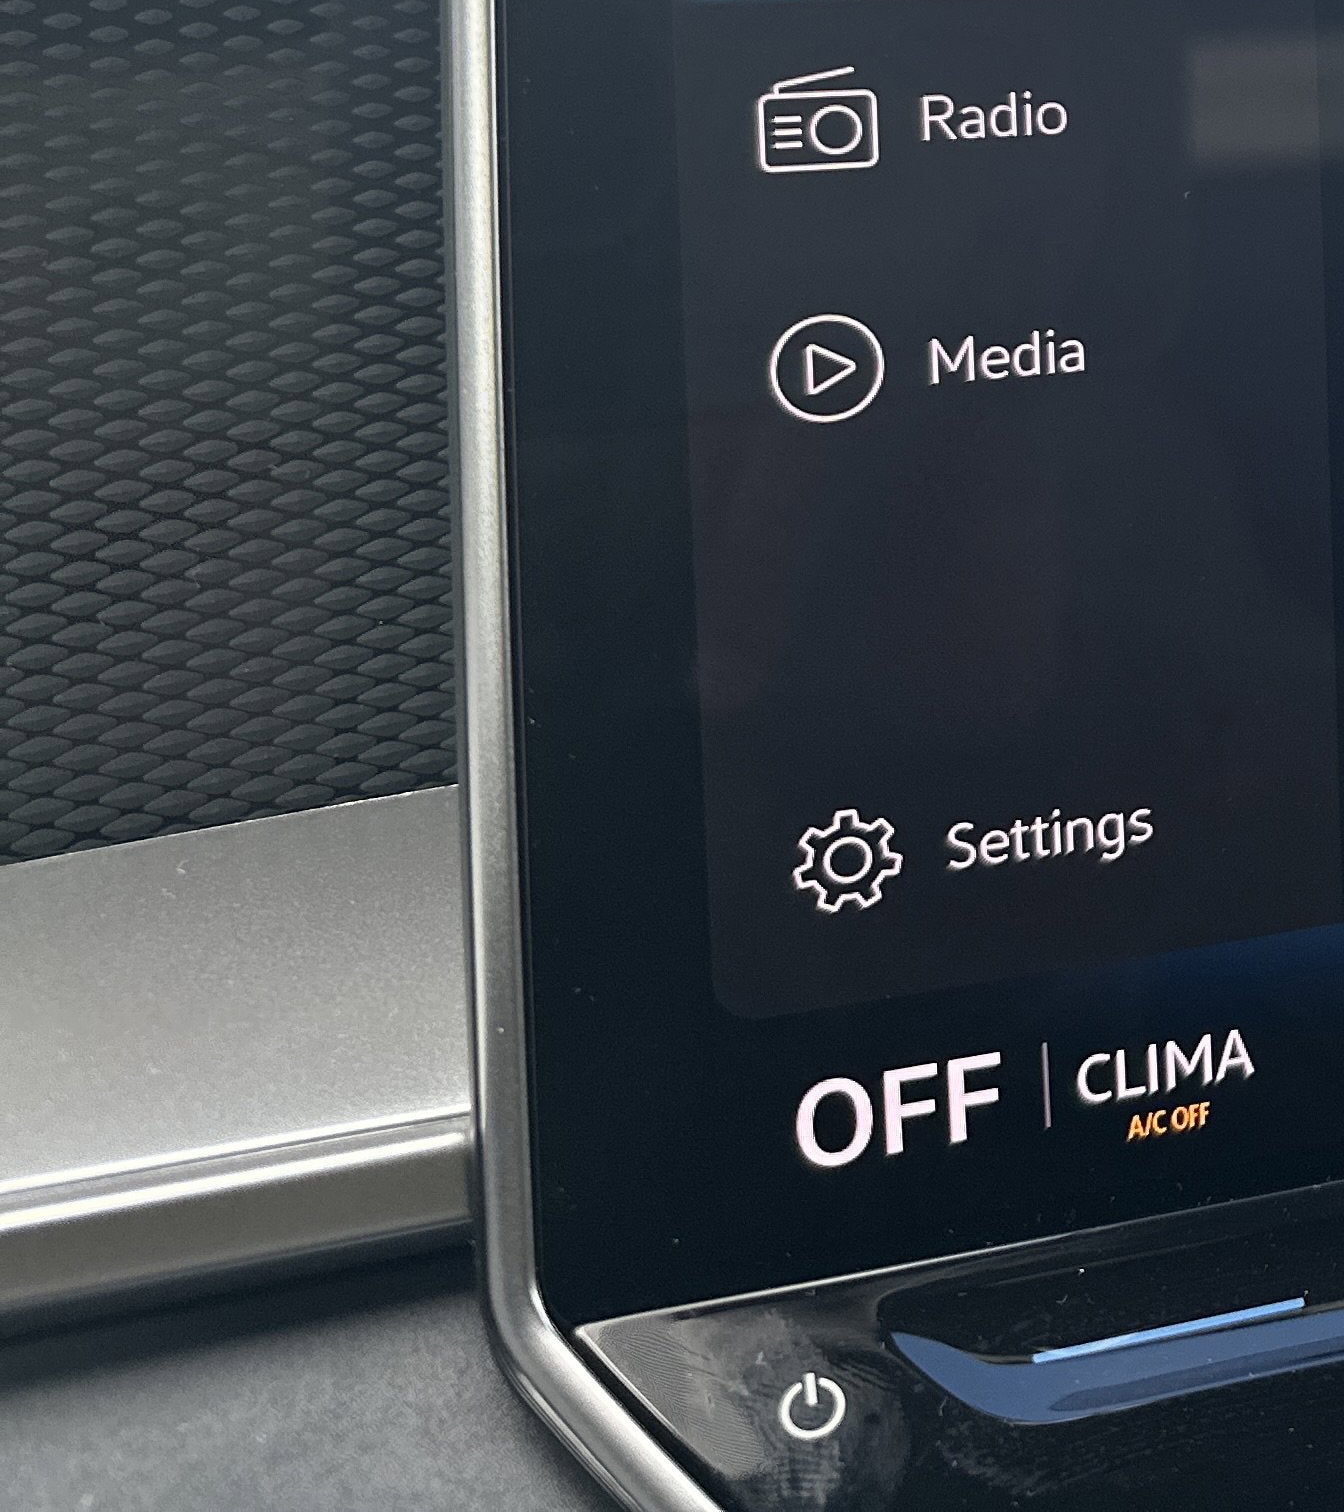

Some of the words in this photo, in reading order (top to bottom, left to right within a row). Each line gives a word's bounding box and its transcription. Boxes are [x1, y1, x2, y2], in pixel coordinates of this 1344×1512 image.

[920, 90, 1068, 141] Radio
[929, 329, 1085, 385] Media
[947, 808, 1154, 870] Settings
[1076, 1029, 1255, 1107] CLIMA
[795, 1051, 1001, 1168] OFF
[1127, 1109, 1168, 1142] A/C
[1170, 1101, 1211, 1132] OFF
